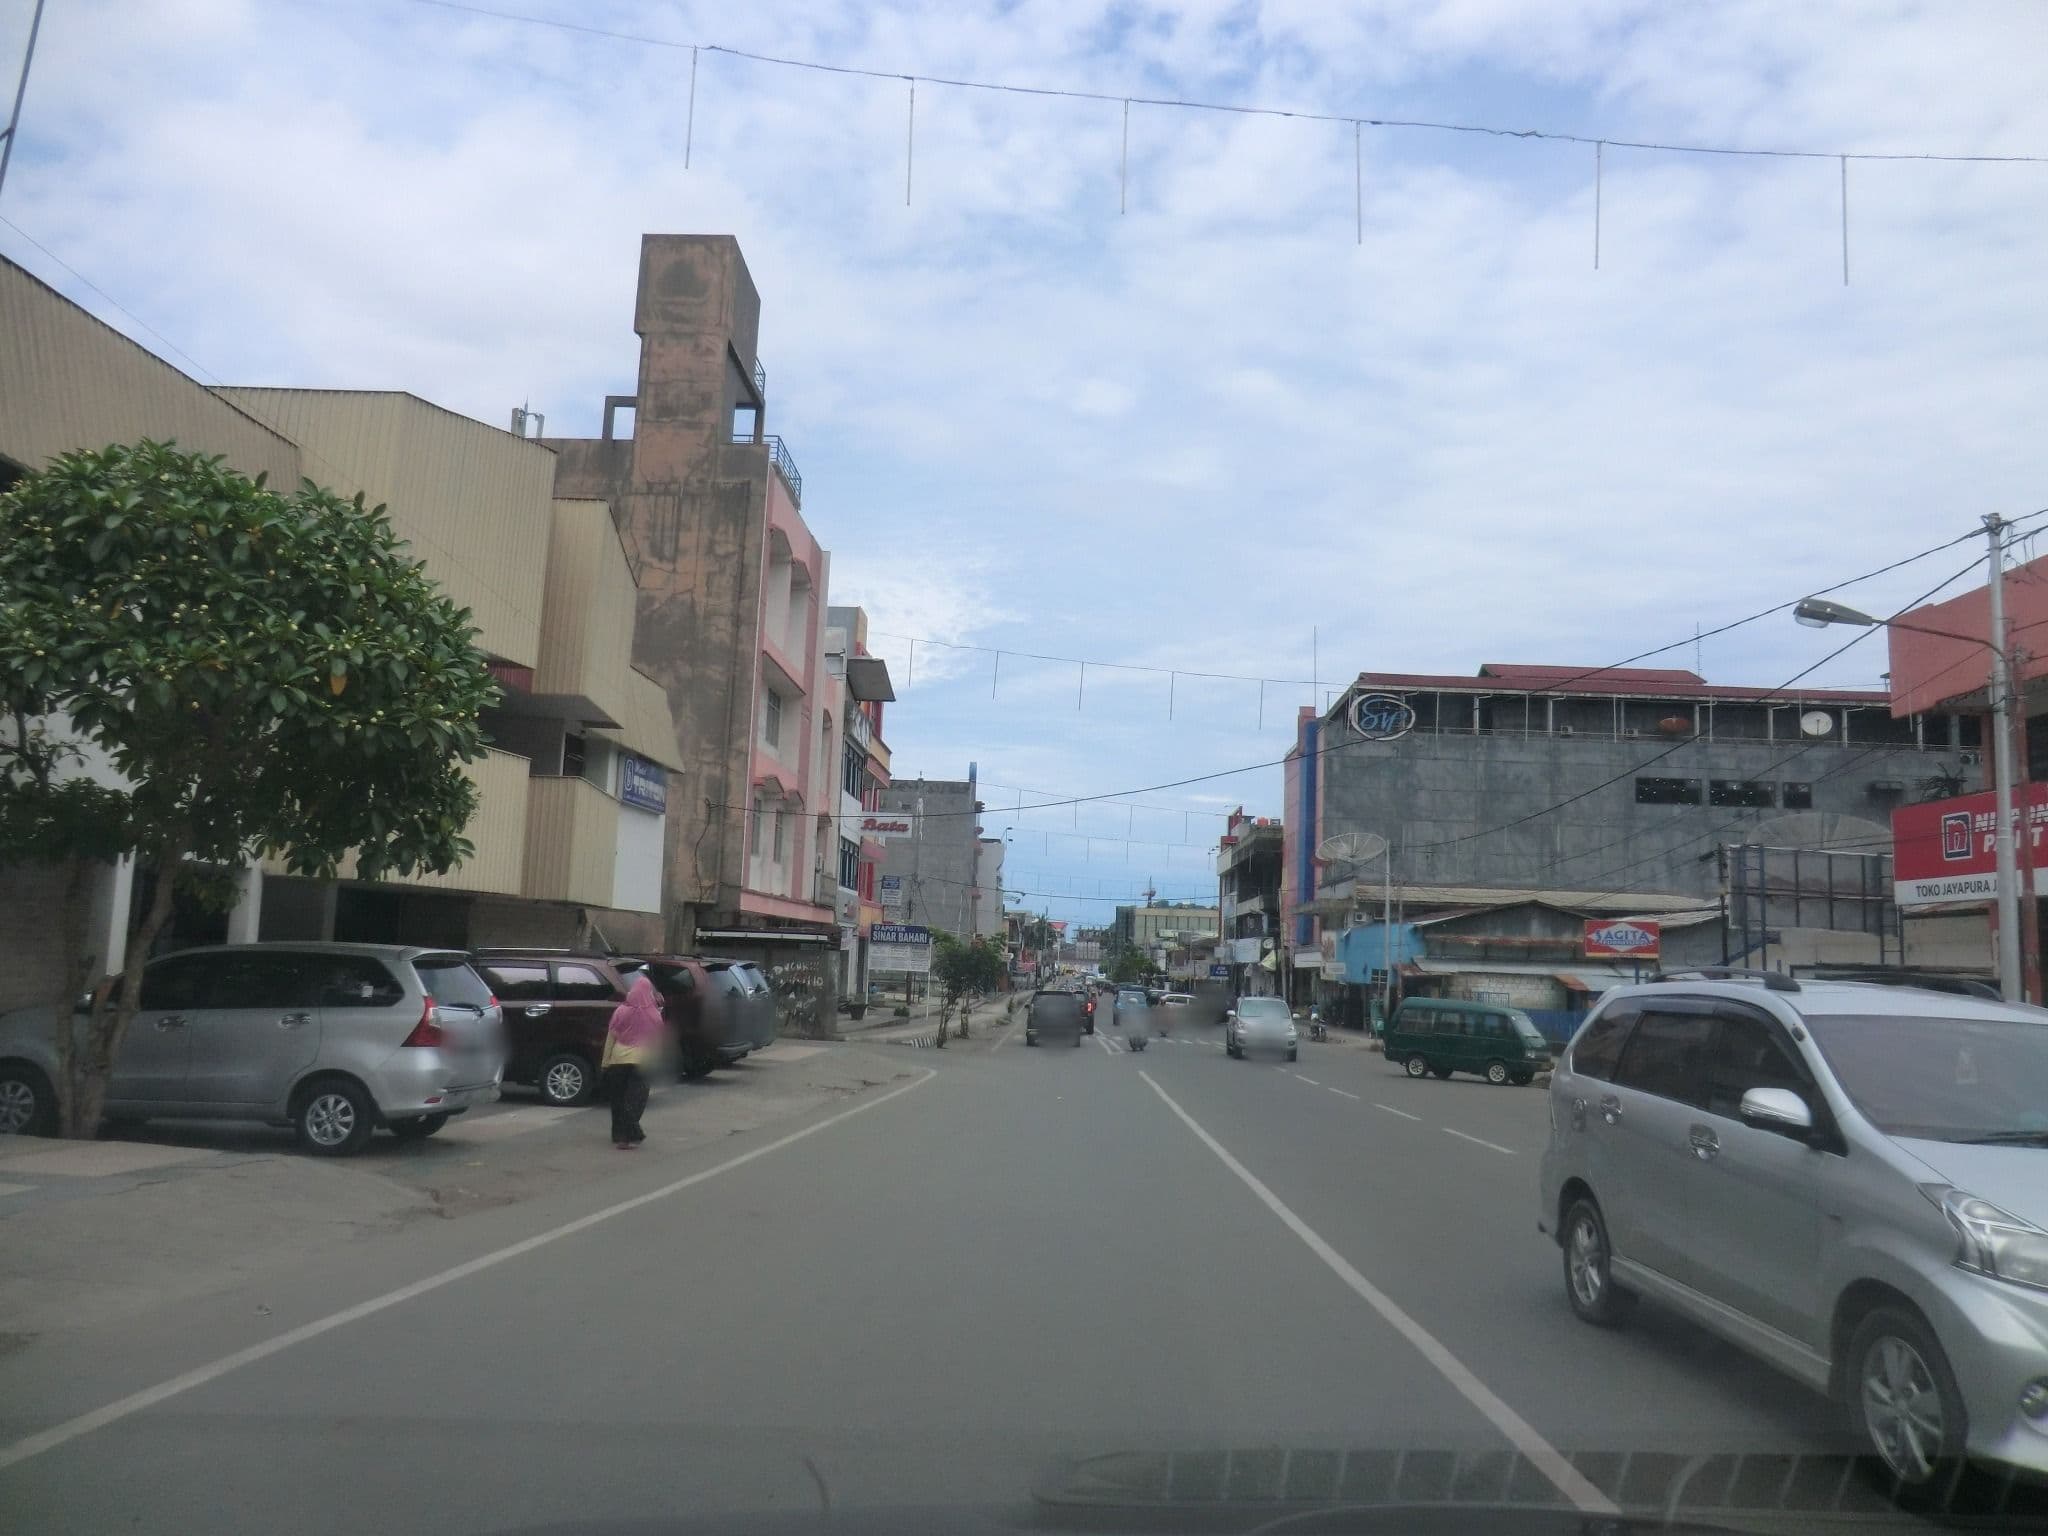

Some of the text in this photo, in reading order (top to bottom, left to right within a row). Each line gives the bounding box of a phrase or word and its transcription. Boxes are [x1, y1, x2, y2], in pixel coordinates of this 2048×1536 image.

[861, 818, 910, 832] Bata
[1916, 885, 1939, 897] TOKO
[1942, 881, 1991, 896] JAYAPURA
[880, 925, 906, 933] APOTEK
[872, 931, 927, 944] SINAR BAHARI
[1595, 929, 1650, 944] SAGITA
